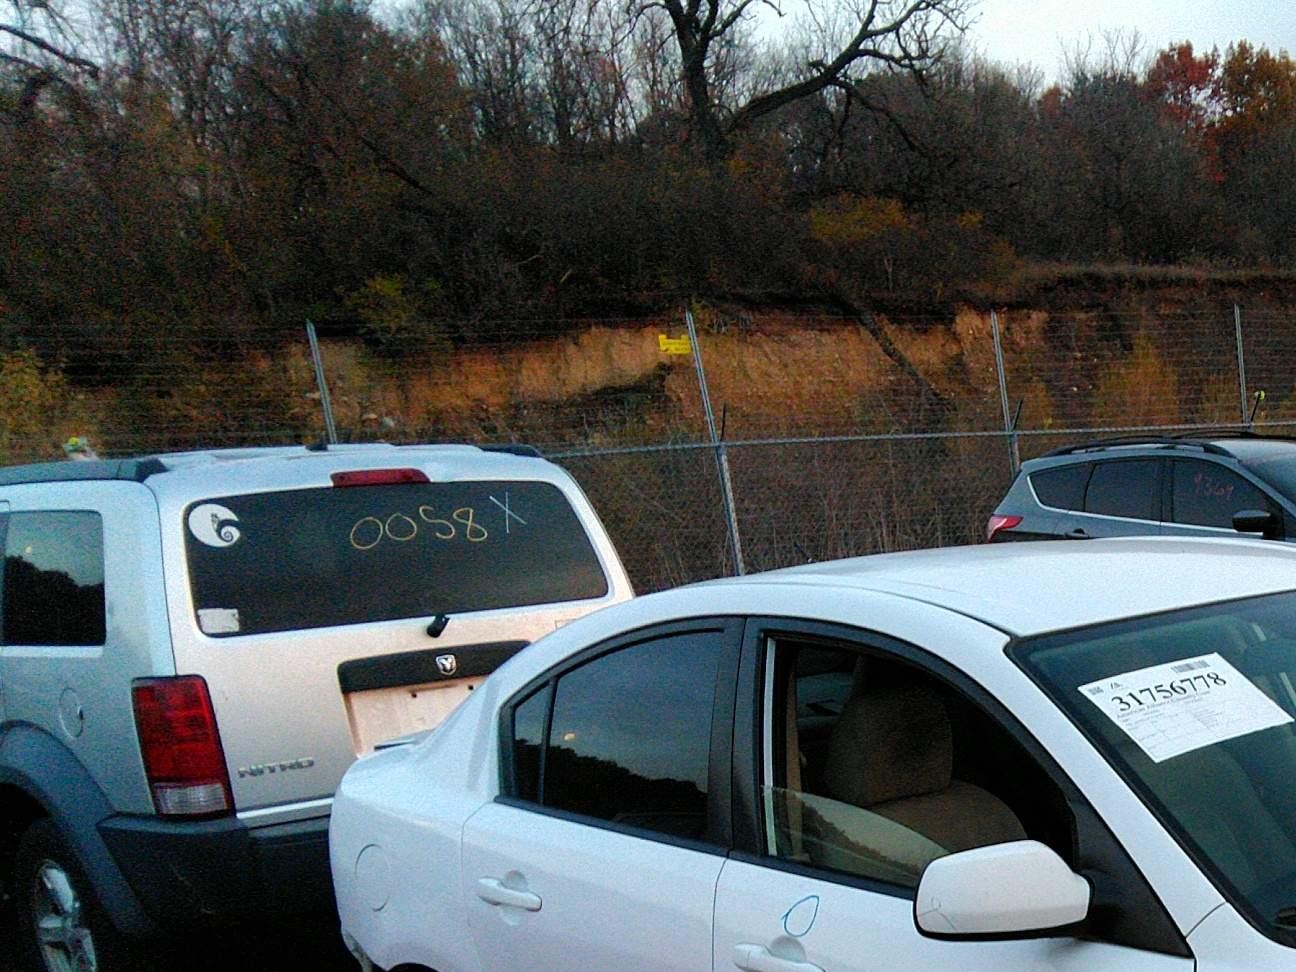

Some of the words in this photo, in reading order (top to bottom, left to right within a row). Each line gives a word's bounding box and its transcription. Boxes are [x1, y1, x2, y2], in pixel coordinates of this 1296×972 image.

[350, 505, 488, 549] 0058
[1111, 671, 1227, 712] 31756778
[238, 756, 314, 778] NITRO
